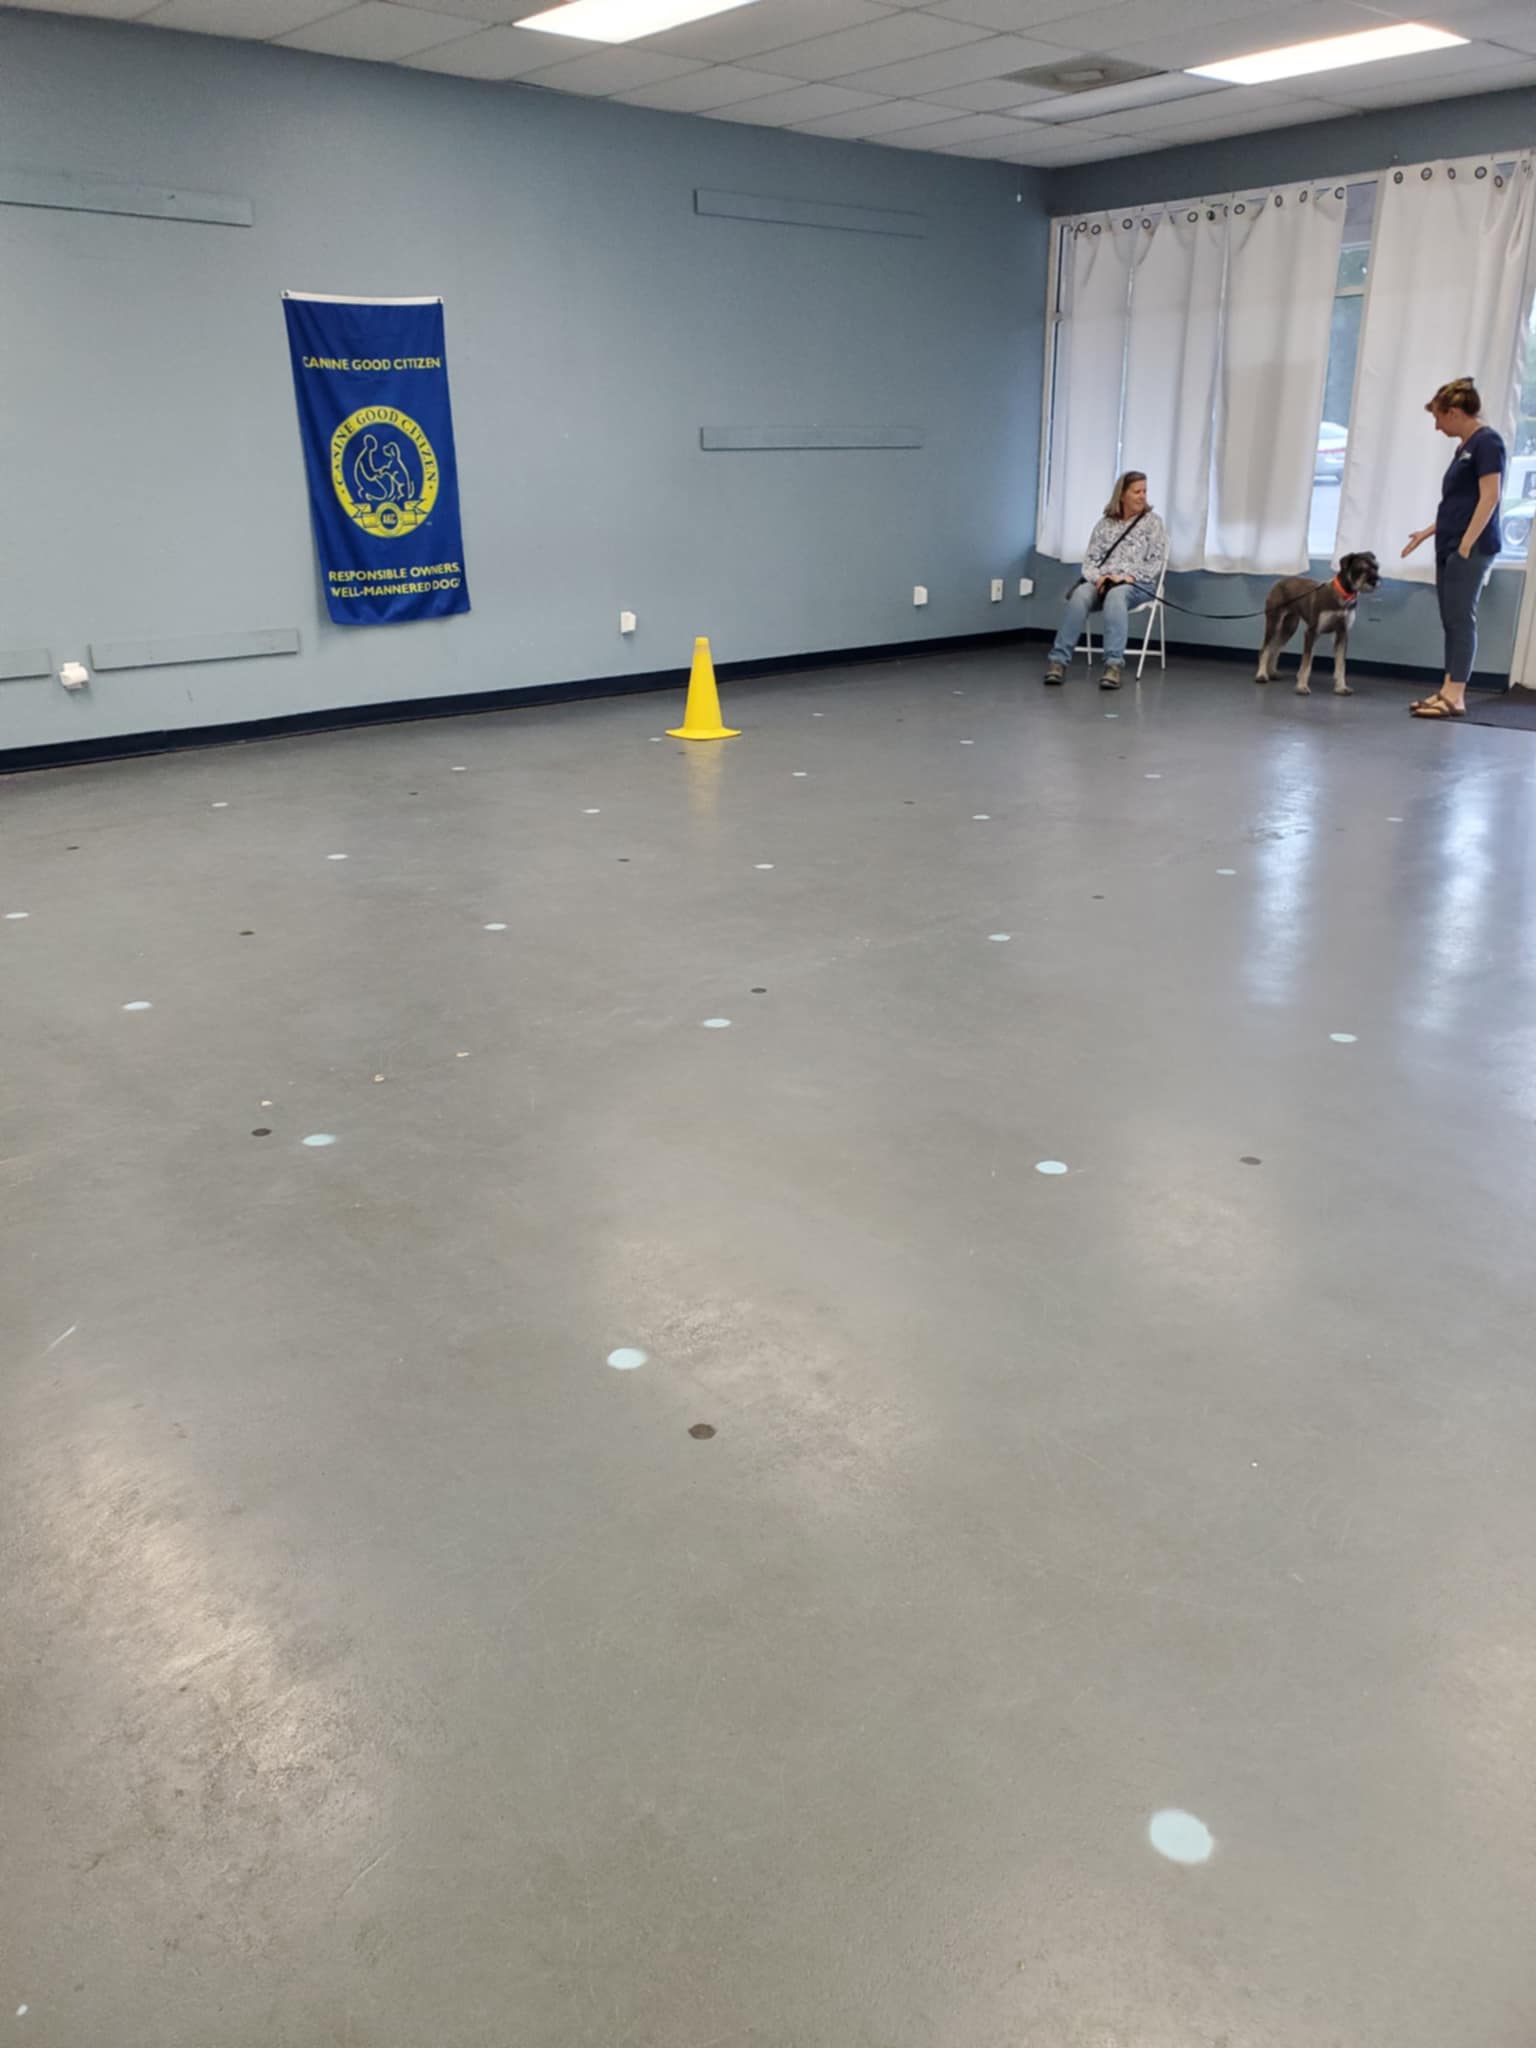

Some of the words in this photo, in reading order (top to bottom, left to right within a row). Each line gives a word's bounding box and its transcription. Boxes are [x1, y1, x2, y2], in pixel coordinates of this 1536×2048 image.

[302, 356, 350, 371] CANINE
[352, 359, 391, 371] GOOD
[393, 357, 441, 371] CITIZEN
[333, 422, 353, 486] CANINE
[355, 408, 399, 425] GOOD
[401, 418, 436, 482] CITIZEN
[328, 568, 407, 582] RESPONSIBLE
